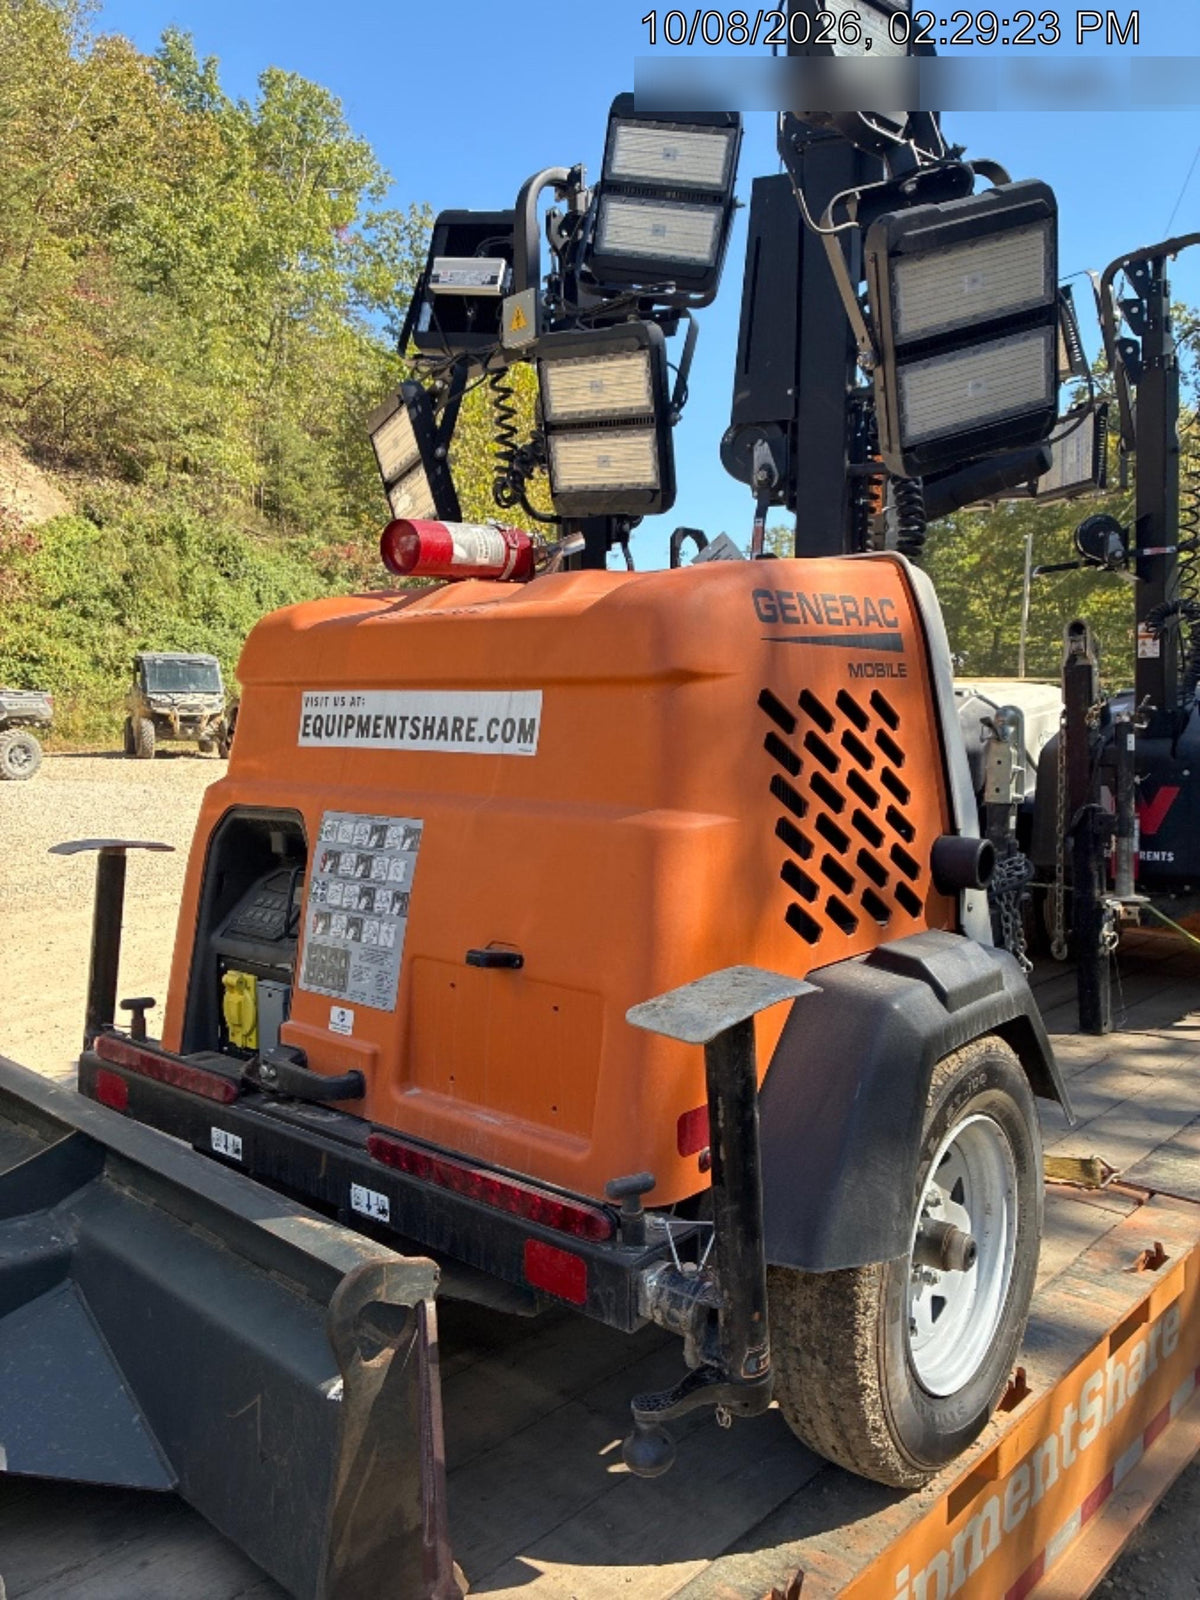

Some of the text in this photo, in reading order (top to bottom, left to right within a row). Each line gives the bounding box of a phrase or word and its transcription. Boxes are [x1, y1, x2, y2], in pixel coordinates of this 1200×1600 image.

[752, 588, 899, 629] GENERAC
[848, 662, 907, 678] MOBILE
[304, 696, 365, 707] VISIT US AT:
[302, 714, 536, 744] EQUIPMENTSHARE.COM
[1138, 850, 1175, 862] RENTS
